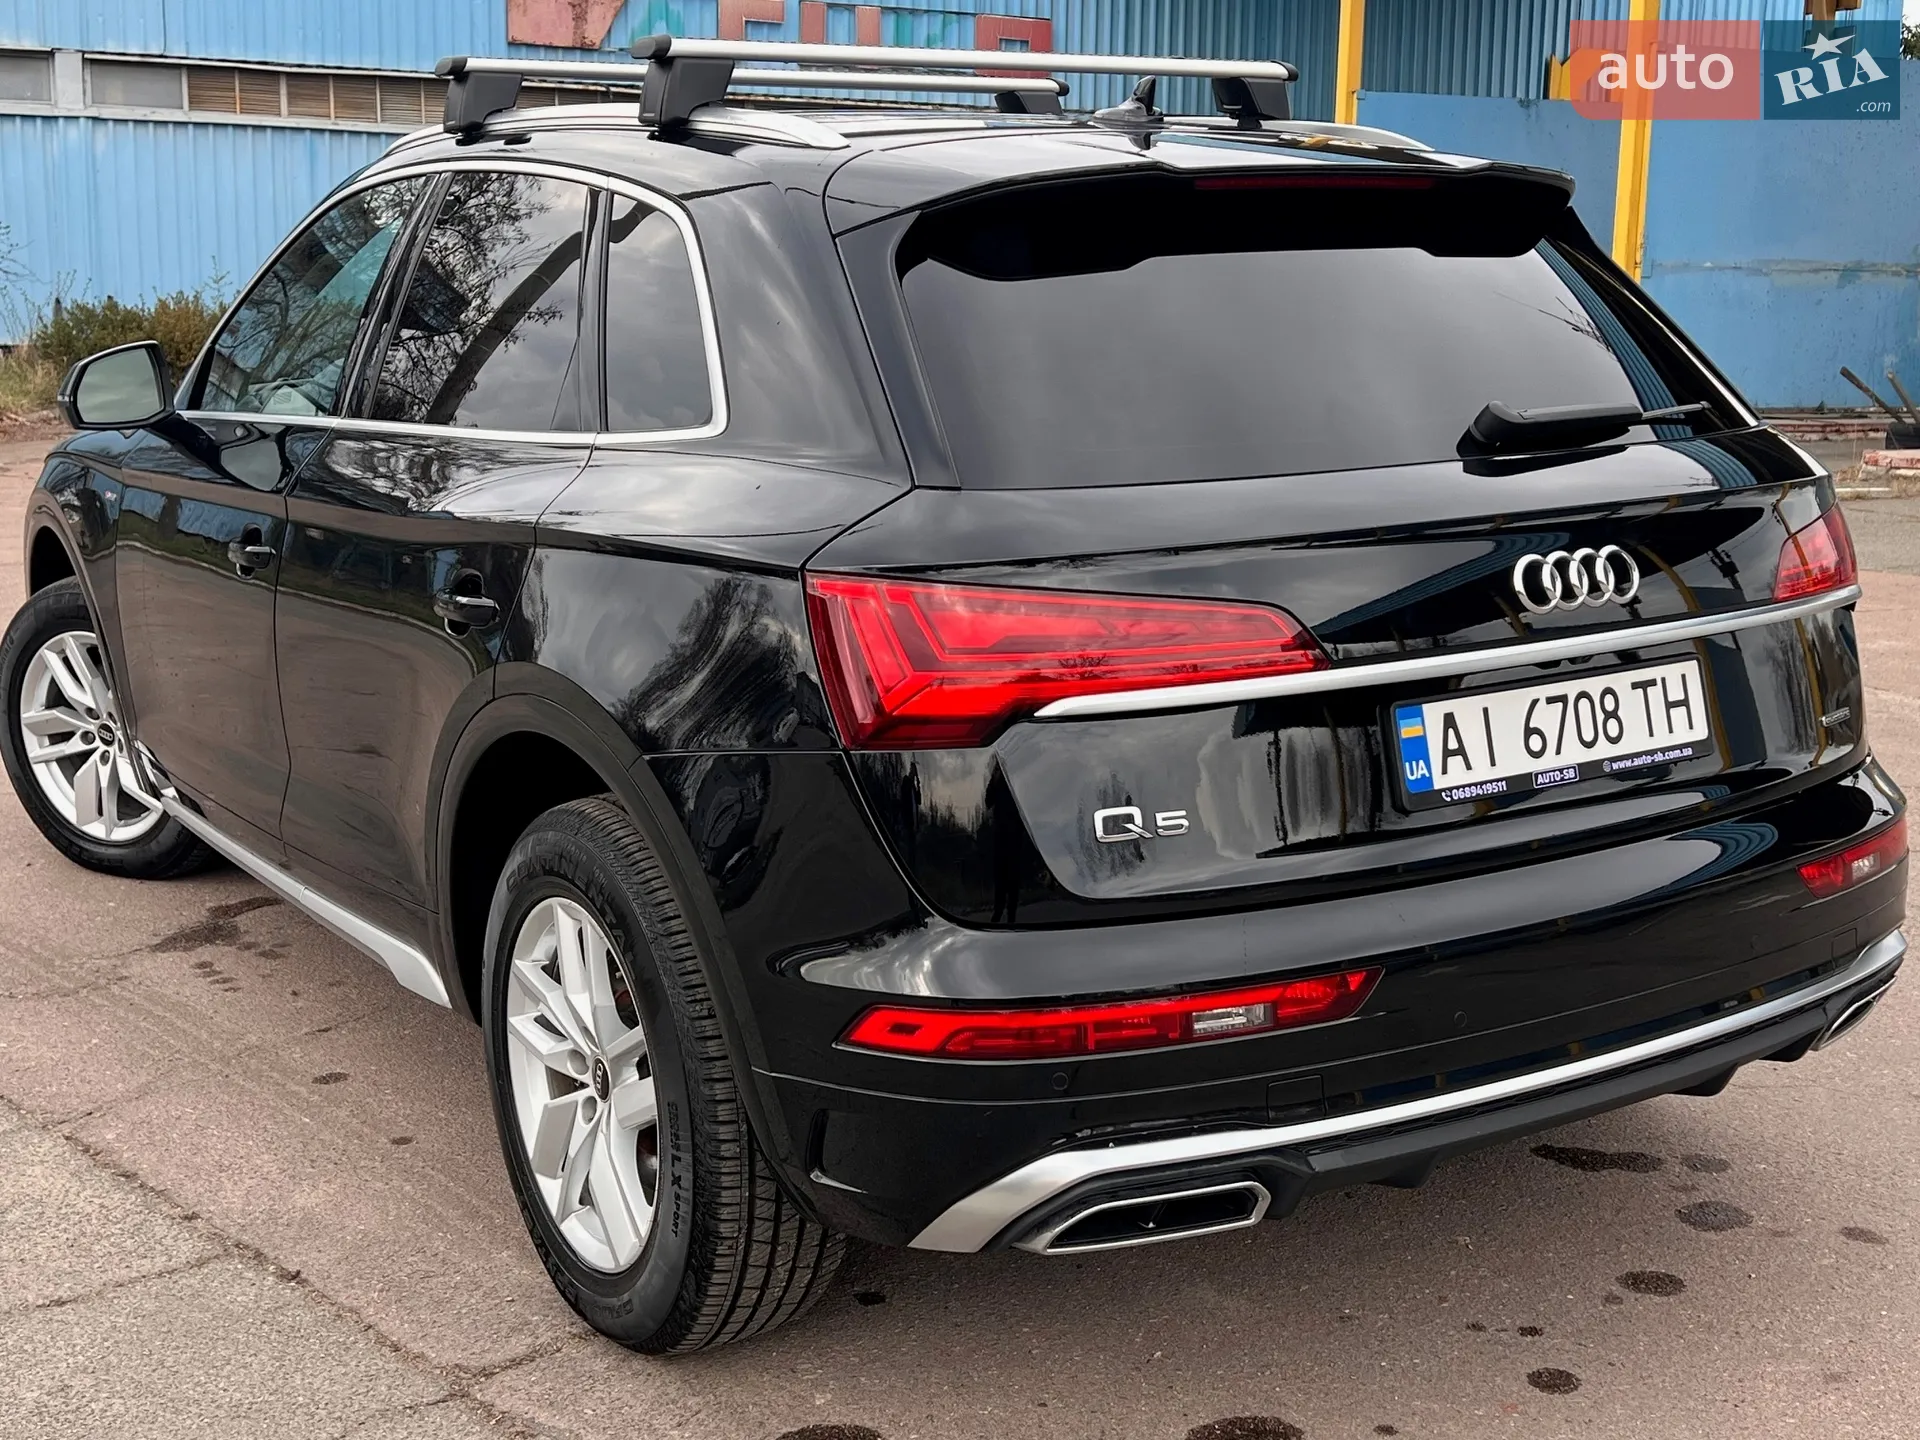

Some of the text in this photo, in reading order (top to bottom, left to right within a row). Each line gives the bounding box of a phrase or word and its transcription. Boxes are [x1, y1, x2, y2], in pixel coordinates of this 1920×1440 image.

[1440, 673, 1694, 776] AI 6708 TH
[1405, 758, 1430, 781] UA
[1611, 747, 1693, 771] www.auto-sb.com.ua
[1536, 767, 1576, 786] AUTO-SB
[1451, 780, 1508, 801] 0689419511
[1094, 805, 1189, 843] Q5
